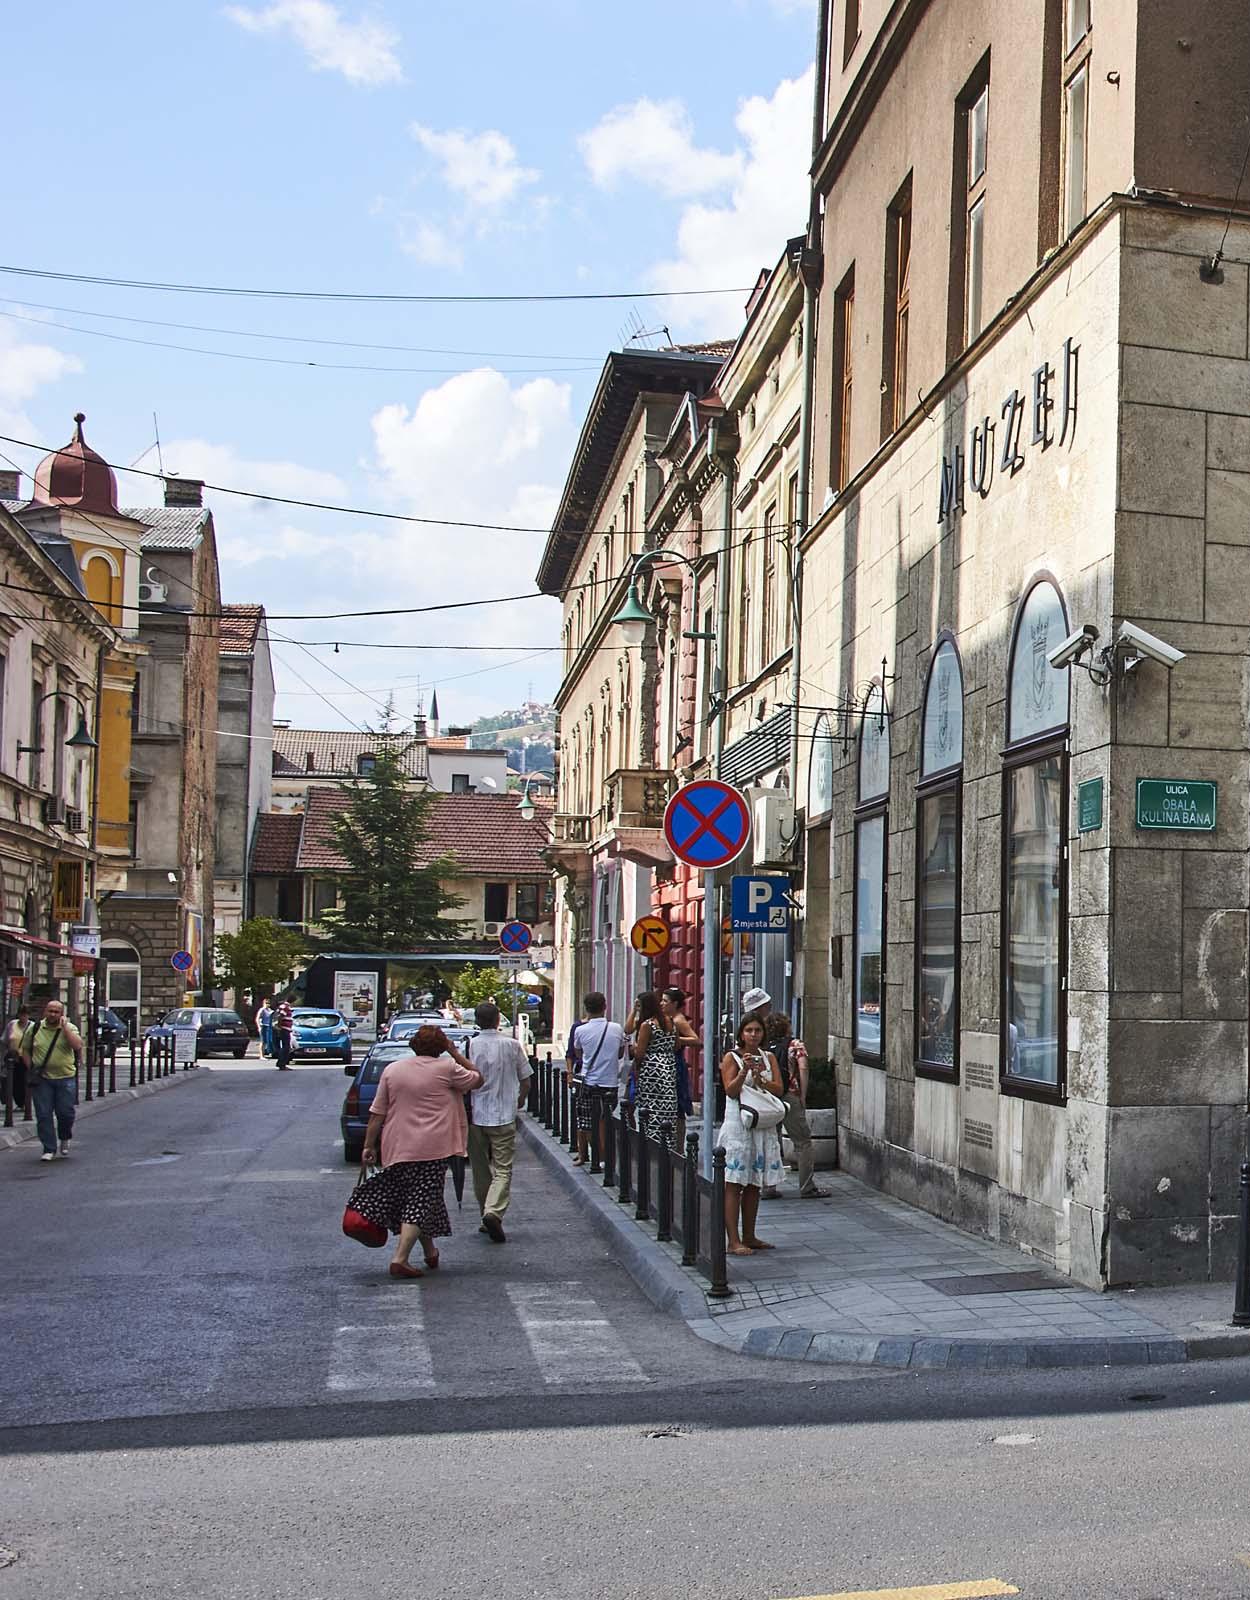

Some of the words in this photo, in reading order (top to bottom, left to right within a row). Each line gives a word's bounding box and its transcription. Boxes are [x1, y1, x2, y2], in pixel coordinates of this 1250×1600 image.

[937, 337, 1081, 524] MUZEJ
[1165, 784, 1189, 795] ULICA
[1162, 798, 1197, 812] OBALA
[1141, 811, 1180, 823] KULINA
[1182, 812, 1211, 825] BANA
[748, 880, 772, 913] P
